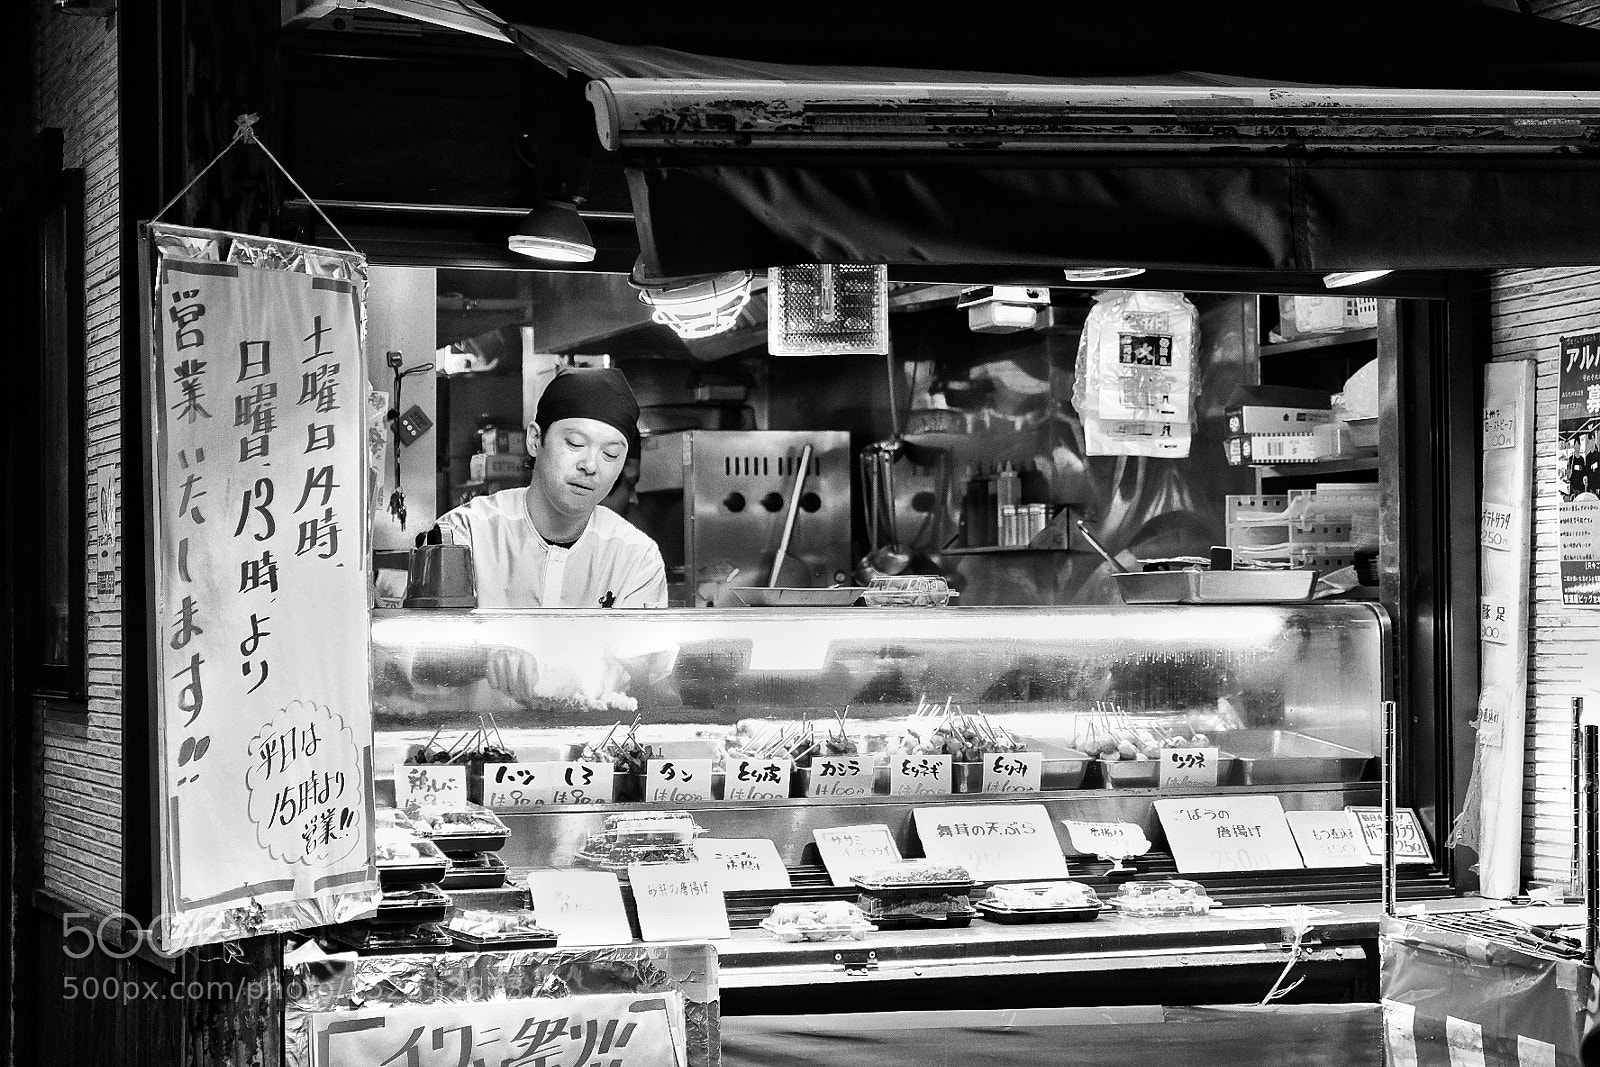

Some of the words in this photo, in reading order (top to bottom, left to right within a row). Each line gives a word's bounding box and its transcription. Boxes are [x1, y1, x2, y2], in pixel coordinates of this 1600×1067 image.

[659, 762, 693, 783] タン
[819, 760, 861, 778] カシラ
